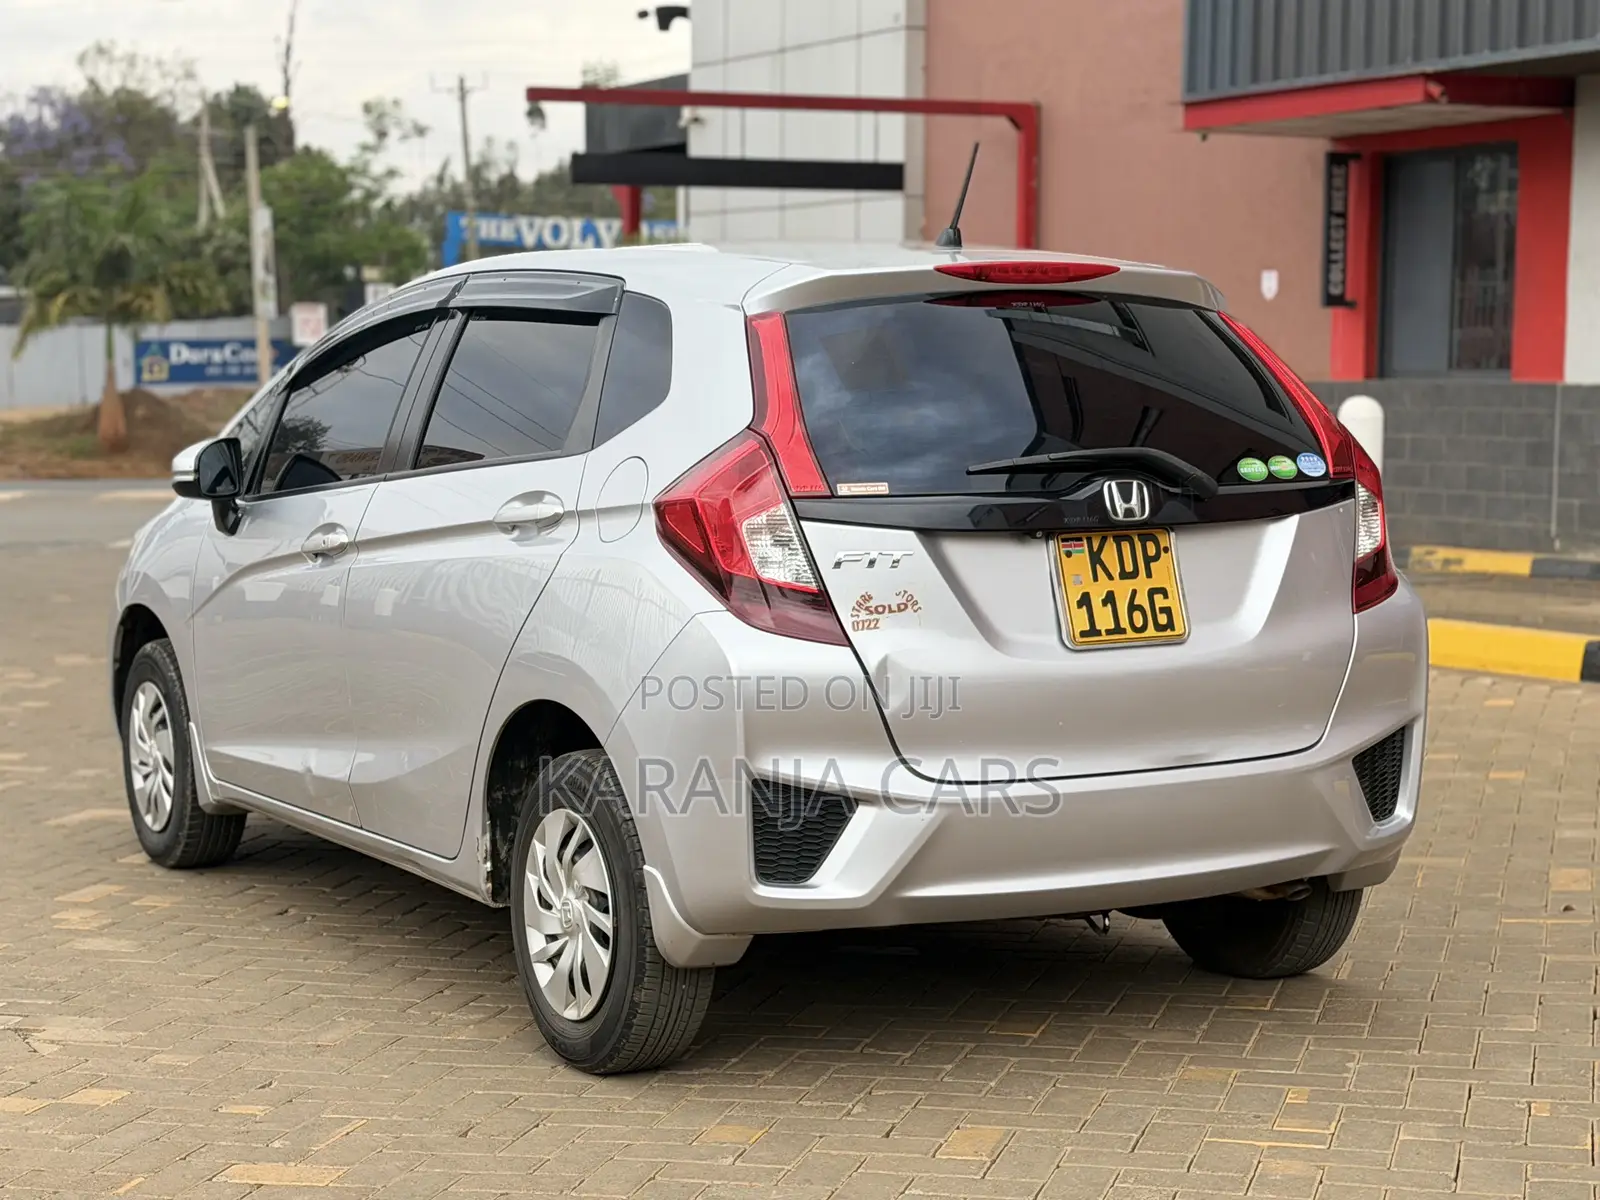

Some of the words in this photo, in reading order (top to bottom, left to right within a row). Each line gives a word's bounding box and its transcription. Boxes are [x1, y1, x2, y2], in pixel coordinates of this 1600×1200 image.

[832, 551, 915, 569] FIT
[1085, 533, 1162, 582] KDP
[864, 602, 909, 616] SOLD
[1076, 587, 1176, 638] 116G
[852, 617, 880, 632] 0722
